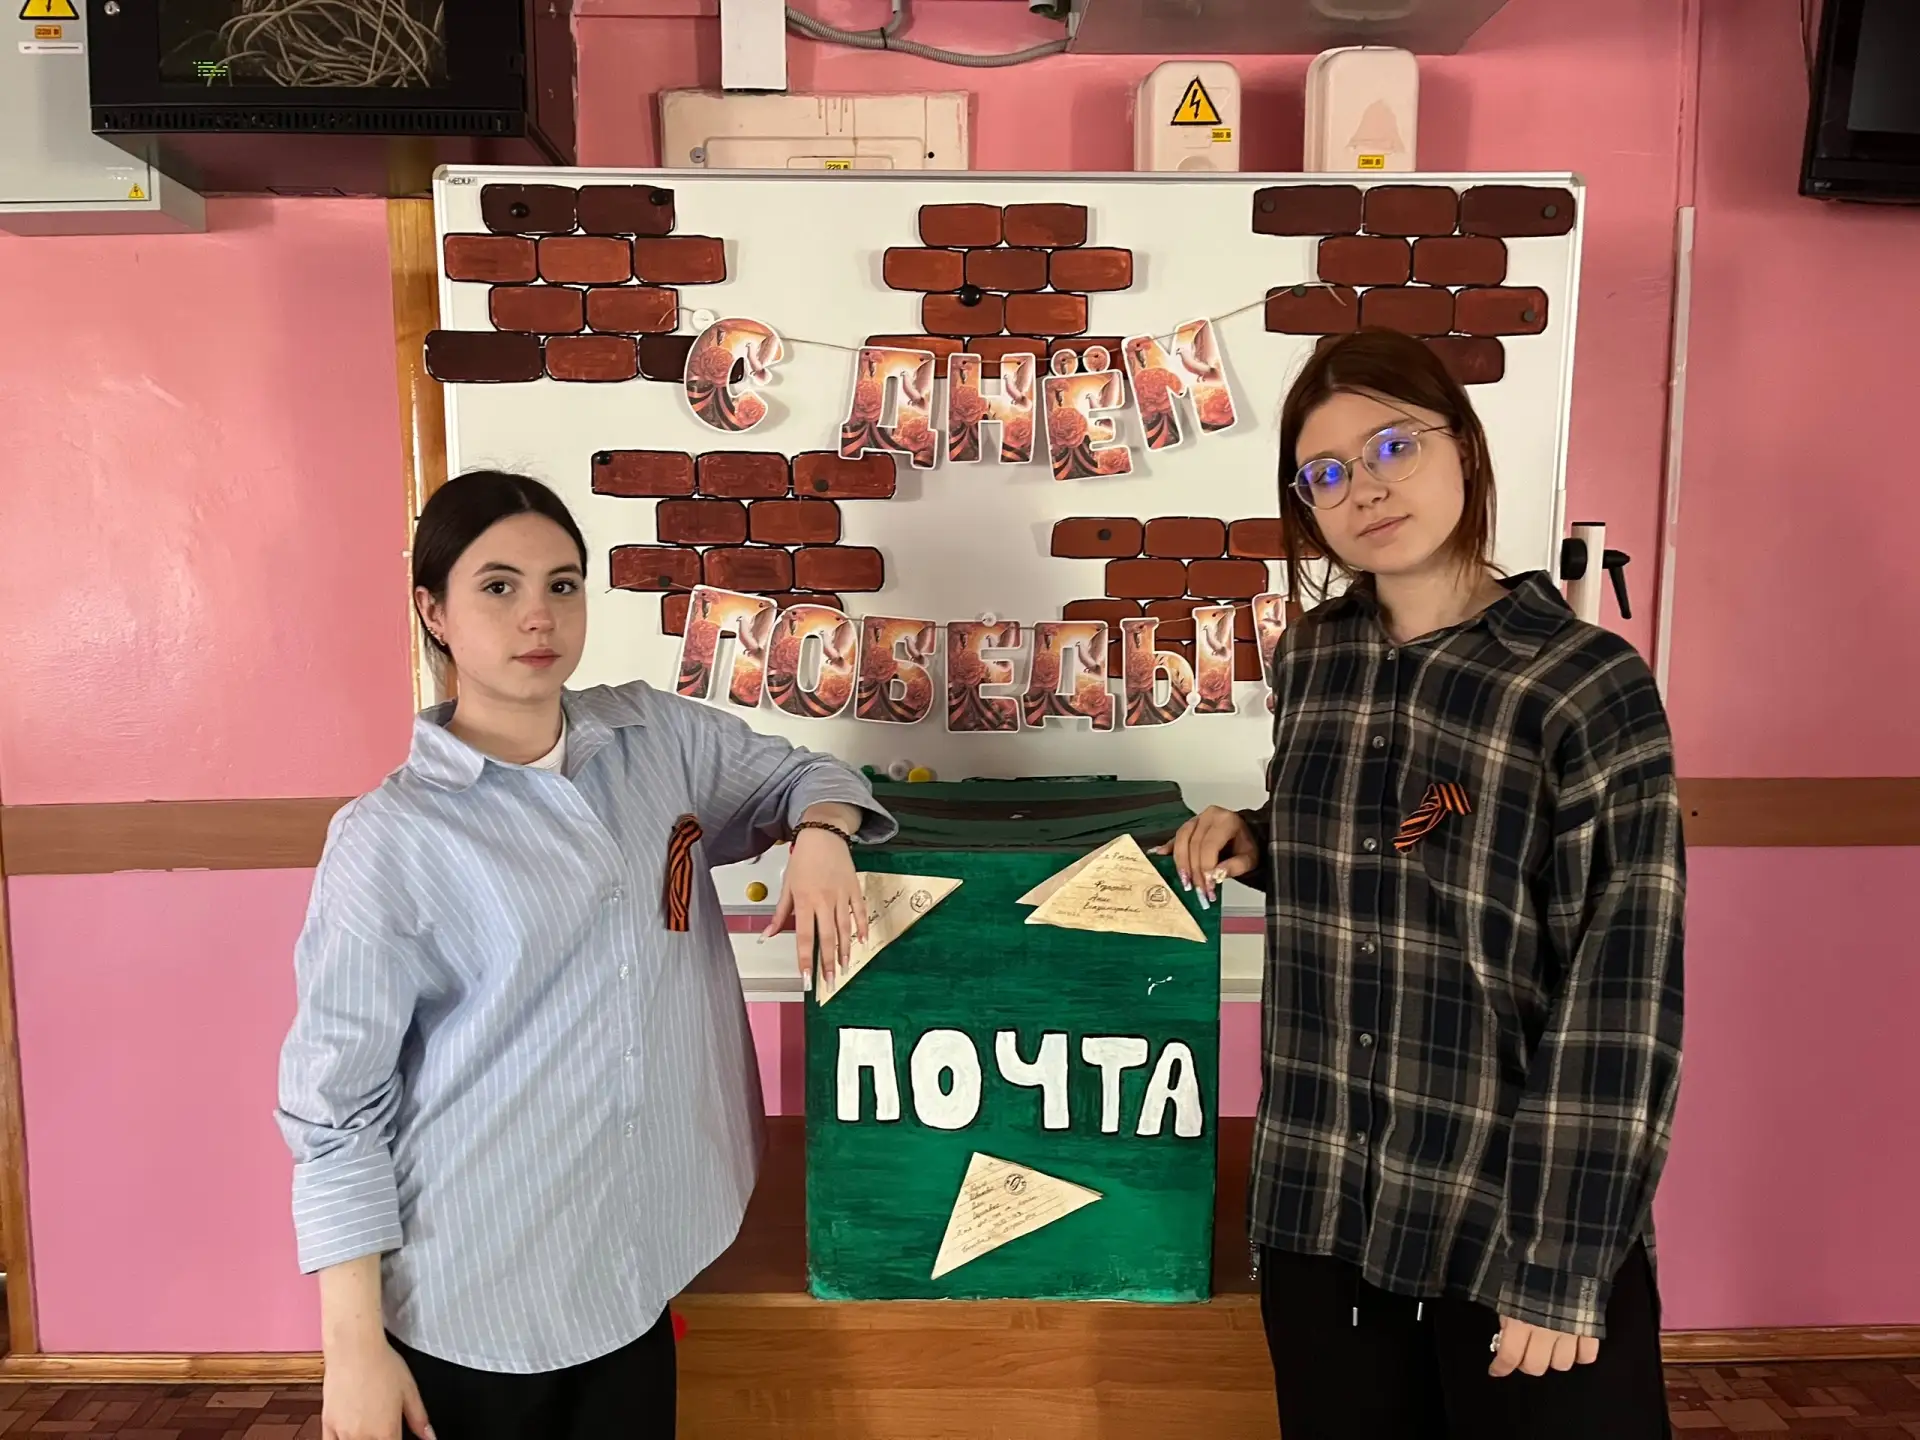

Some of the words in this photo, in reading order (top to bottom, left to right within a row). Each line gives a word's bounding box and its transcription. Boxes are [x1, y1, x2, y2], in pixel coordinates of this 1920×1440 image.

[684, 317, 784, 433] С
[839, 317, 1239, 482] ДНЁМ
[836, 1027, 1202, 1138] ПОЧТА
